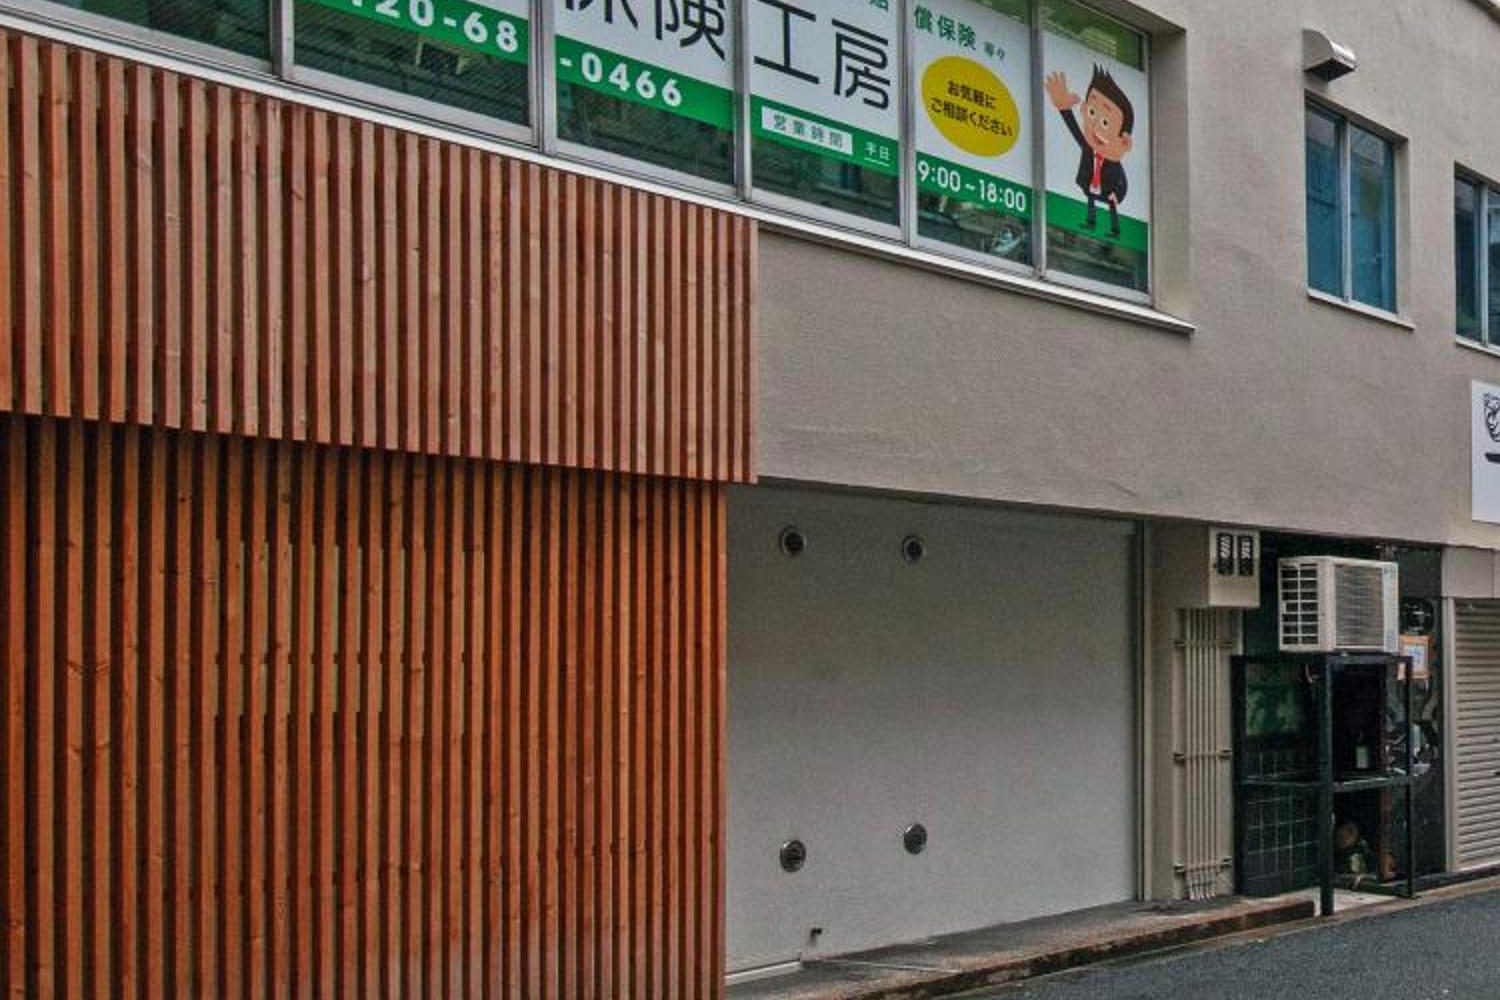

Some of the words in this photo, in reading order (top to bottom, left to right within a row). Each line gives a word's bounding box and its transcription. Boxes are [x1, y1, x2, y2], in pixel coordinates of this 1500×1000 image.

[947, 80, 997, 110] お気軽に
[773, 113, 844, 149] 営業時間
[931, 97, 1014, 137] ご相談ください
